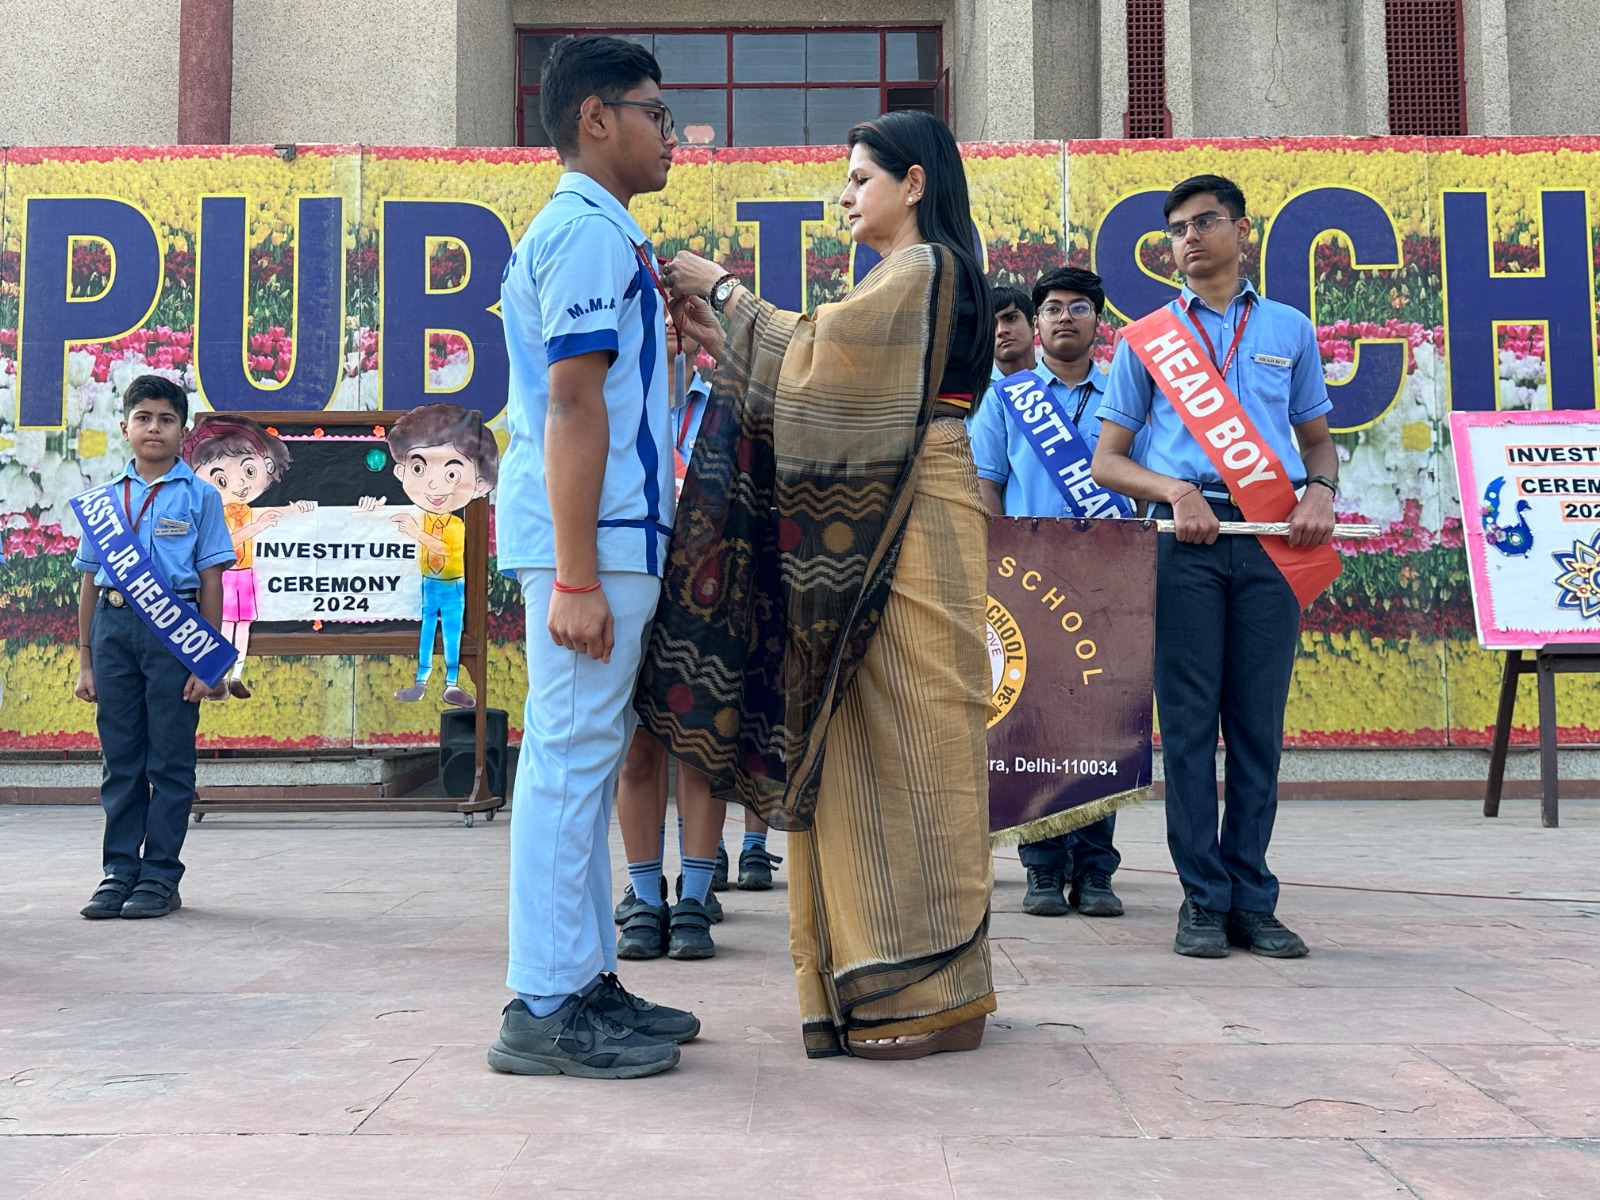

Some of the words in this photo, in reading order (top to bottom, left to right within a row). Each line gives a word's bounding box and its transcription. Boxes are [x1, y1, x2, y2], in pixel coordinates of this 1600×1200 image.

[17, 192, 988, 432] PUBI
[1003, 380, 1073, 456] ASSTT.
[1144, 329, 1224, 418] HEAD
[1205, 416, 1277, 489] BOY
[1508, 447, 1600, 462] INVEST
[256, 542, 416, 559] INVESTITURE
[77, 487, 124, 551] ASSTT.
[107, 544, 140, 581] JR.
[126, 571, 181, 629] HEAD
[169, 618, 220, 664] BOY
[268, 575, 401, 593] CEREMONY
[313, 595, 370, 612] 2024
[997, 556, 1103, 685] SCHOOL
[985, 605, 1024, 664] CHOOL
[986, 631, 1003, 657] OVE
[995, 685, 1016, 710] -34
[986, 759, 1009, 774] ra,
[1015, 757, 1118, 776] Delhi-110034
